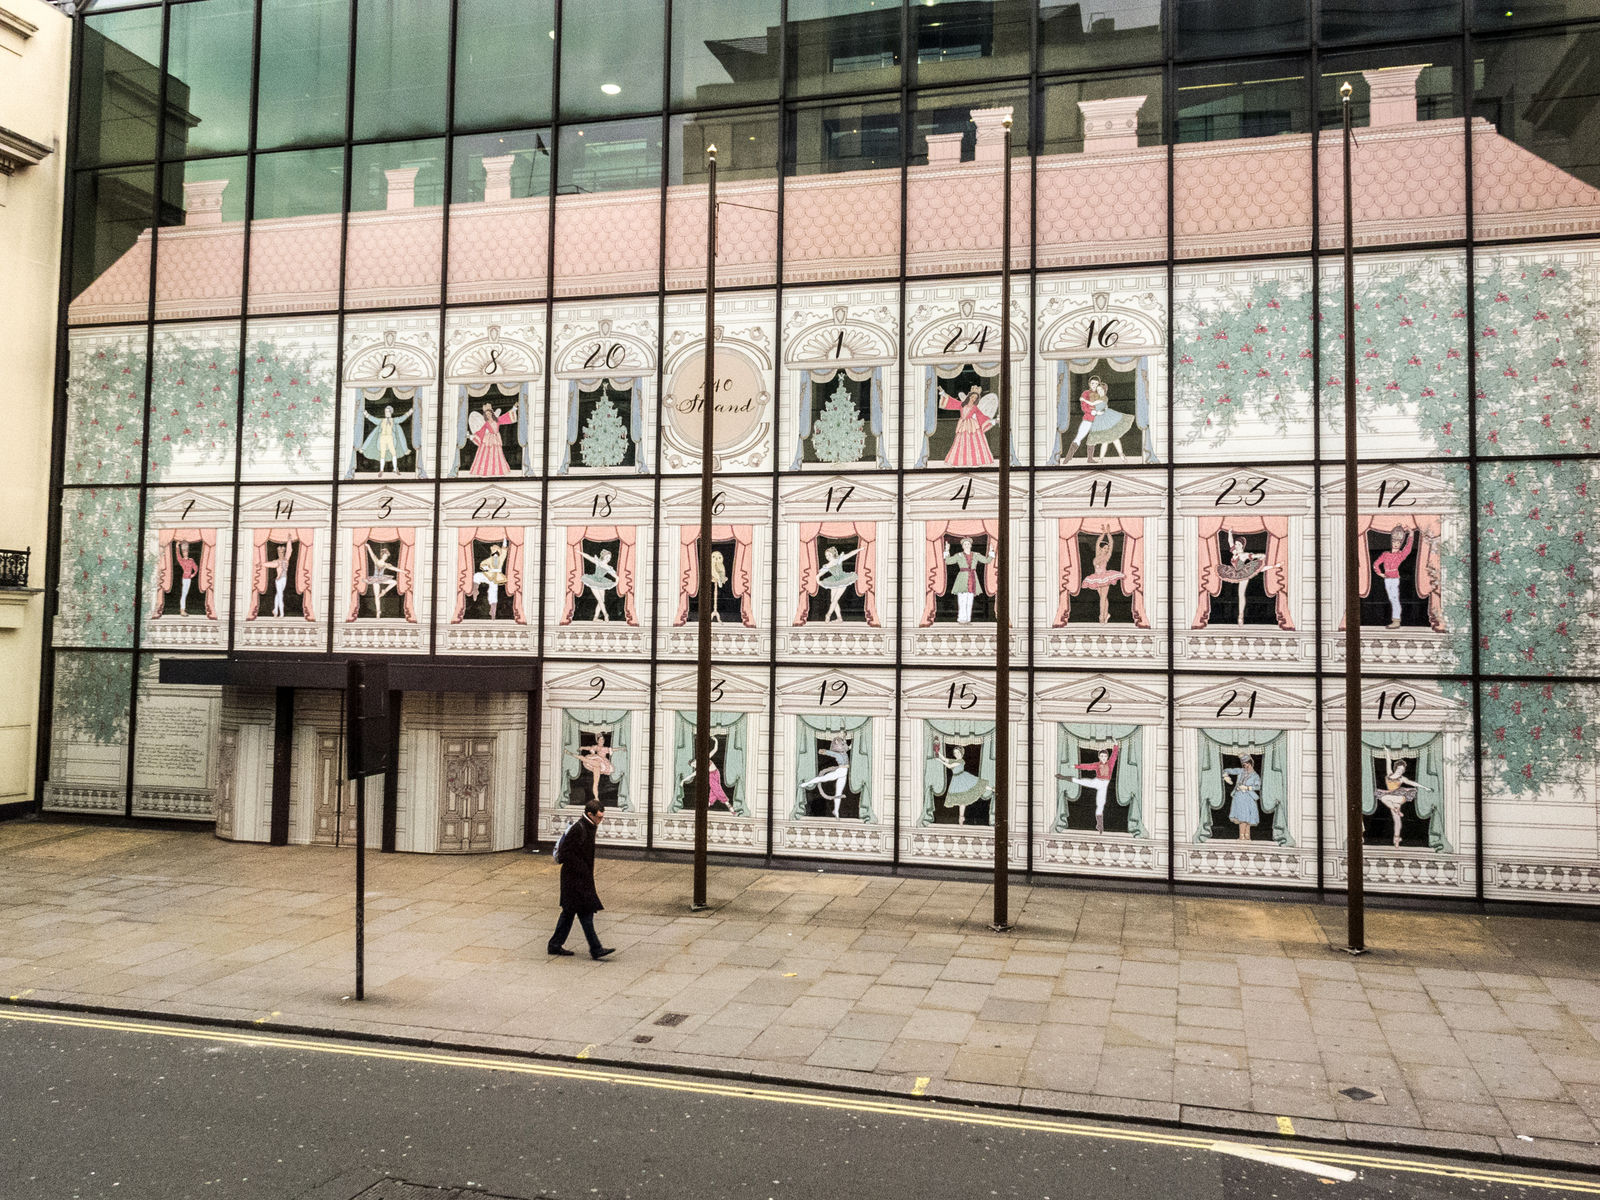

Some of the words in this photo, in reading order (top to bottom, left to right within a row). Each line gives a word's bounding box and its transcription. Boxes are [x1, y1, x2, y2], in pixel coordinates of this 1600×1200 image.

[835, 331, 844, 359] 1
[943, 325, 988, 354] 24
[1086, 319, 1117, 349] 16
[381, 354, 397, 378] 5
[489, 349, 504, 375] 8
[583, 342, 626, 371] 20
[592, 493, 613, 518] 18
[710, 491, 727, 516] 6
[825, 486, 855, 513] 17
[949, 478, 973, 510] 4
[1089, 480, 1112, 508] 11
[1215, 477, 1269, 507] 23
[1377, 479, 1417, 508] 12
[180, 498, 196, 521] 7
[274, 499, 295, 521] 14
[378, 495, 396, 520] 3
[471, 496, 511, 521] 22
[588, 676, 606, 701] 9
[819, 679, 849, 706] 19
[947, 682, 978, 710] 15
[1086, 686, 1112, 714] 2
[1216, 689, 1257, 719] 21
[1377, 691, 1417, 721] 10
